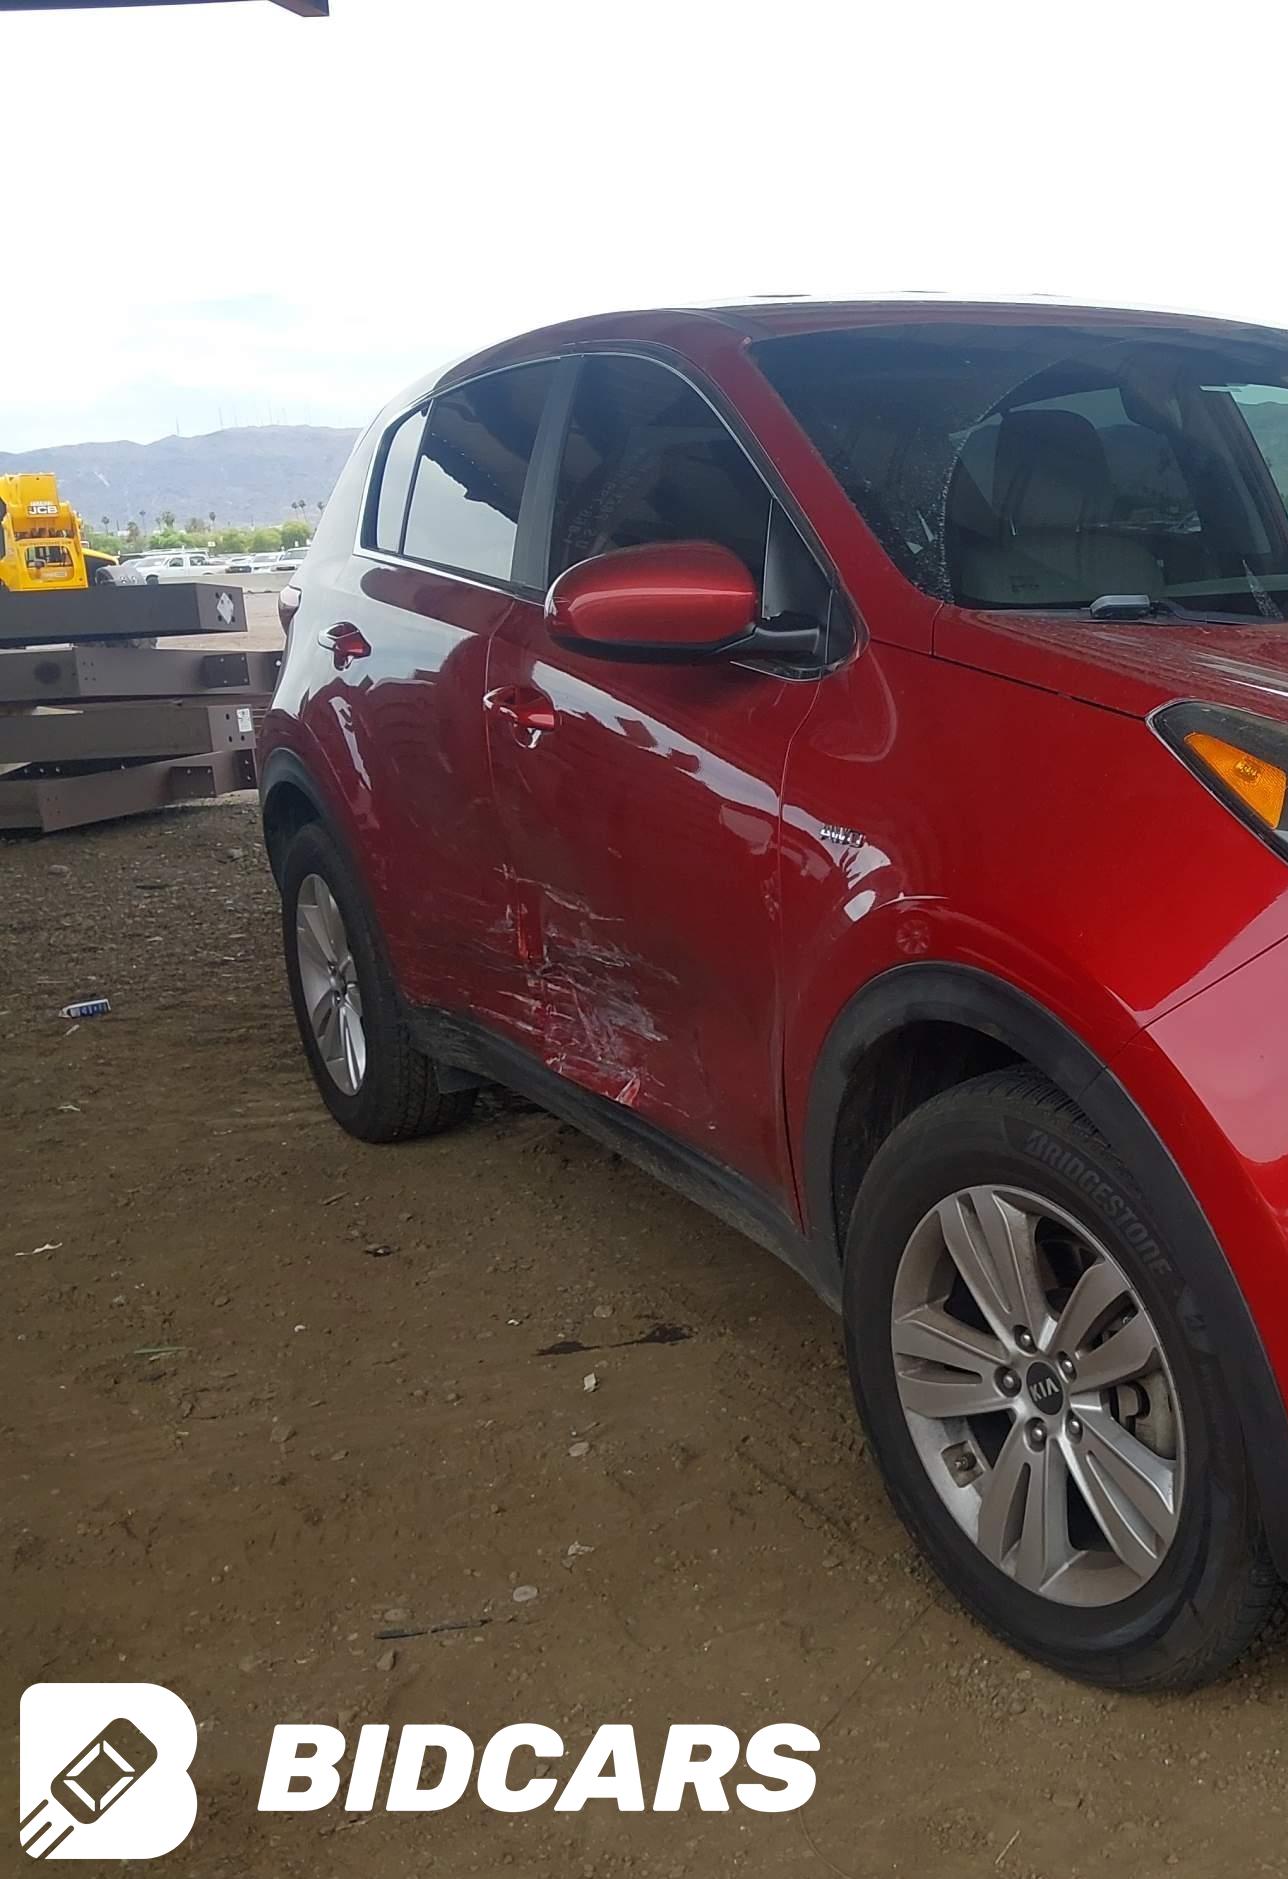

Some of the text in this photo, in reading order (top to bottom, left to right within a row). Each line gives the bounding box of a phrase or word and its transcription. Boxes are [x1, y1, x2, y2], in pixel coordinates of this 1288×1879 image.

[28, 506, 58, 515] JCB
[1026, 1131, 1171, 1275] BRIDGESTONE
[1029, 1377, 1060, 1402] KIA
